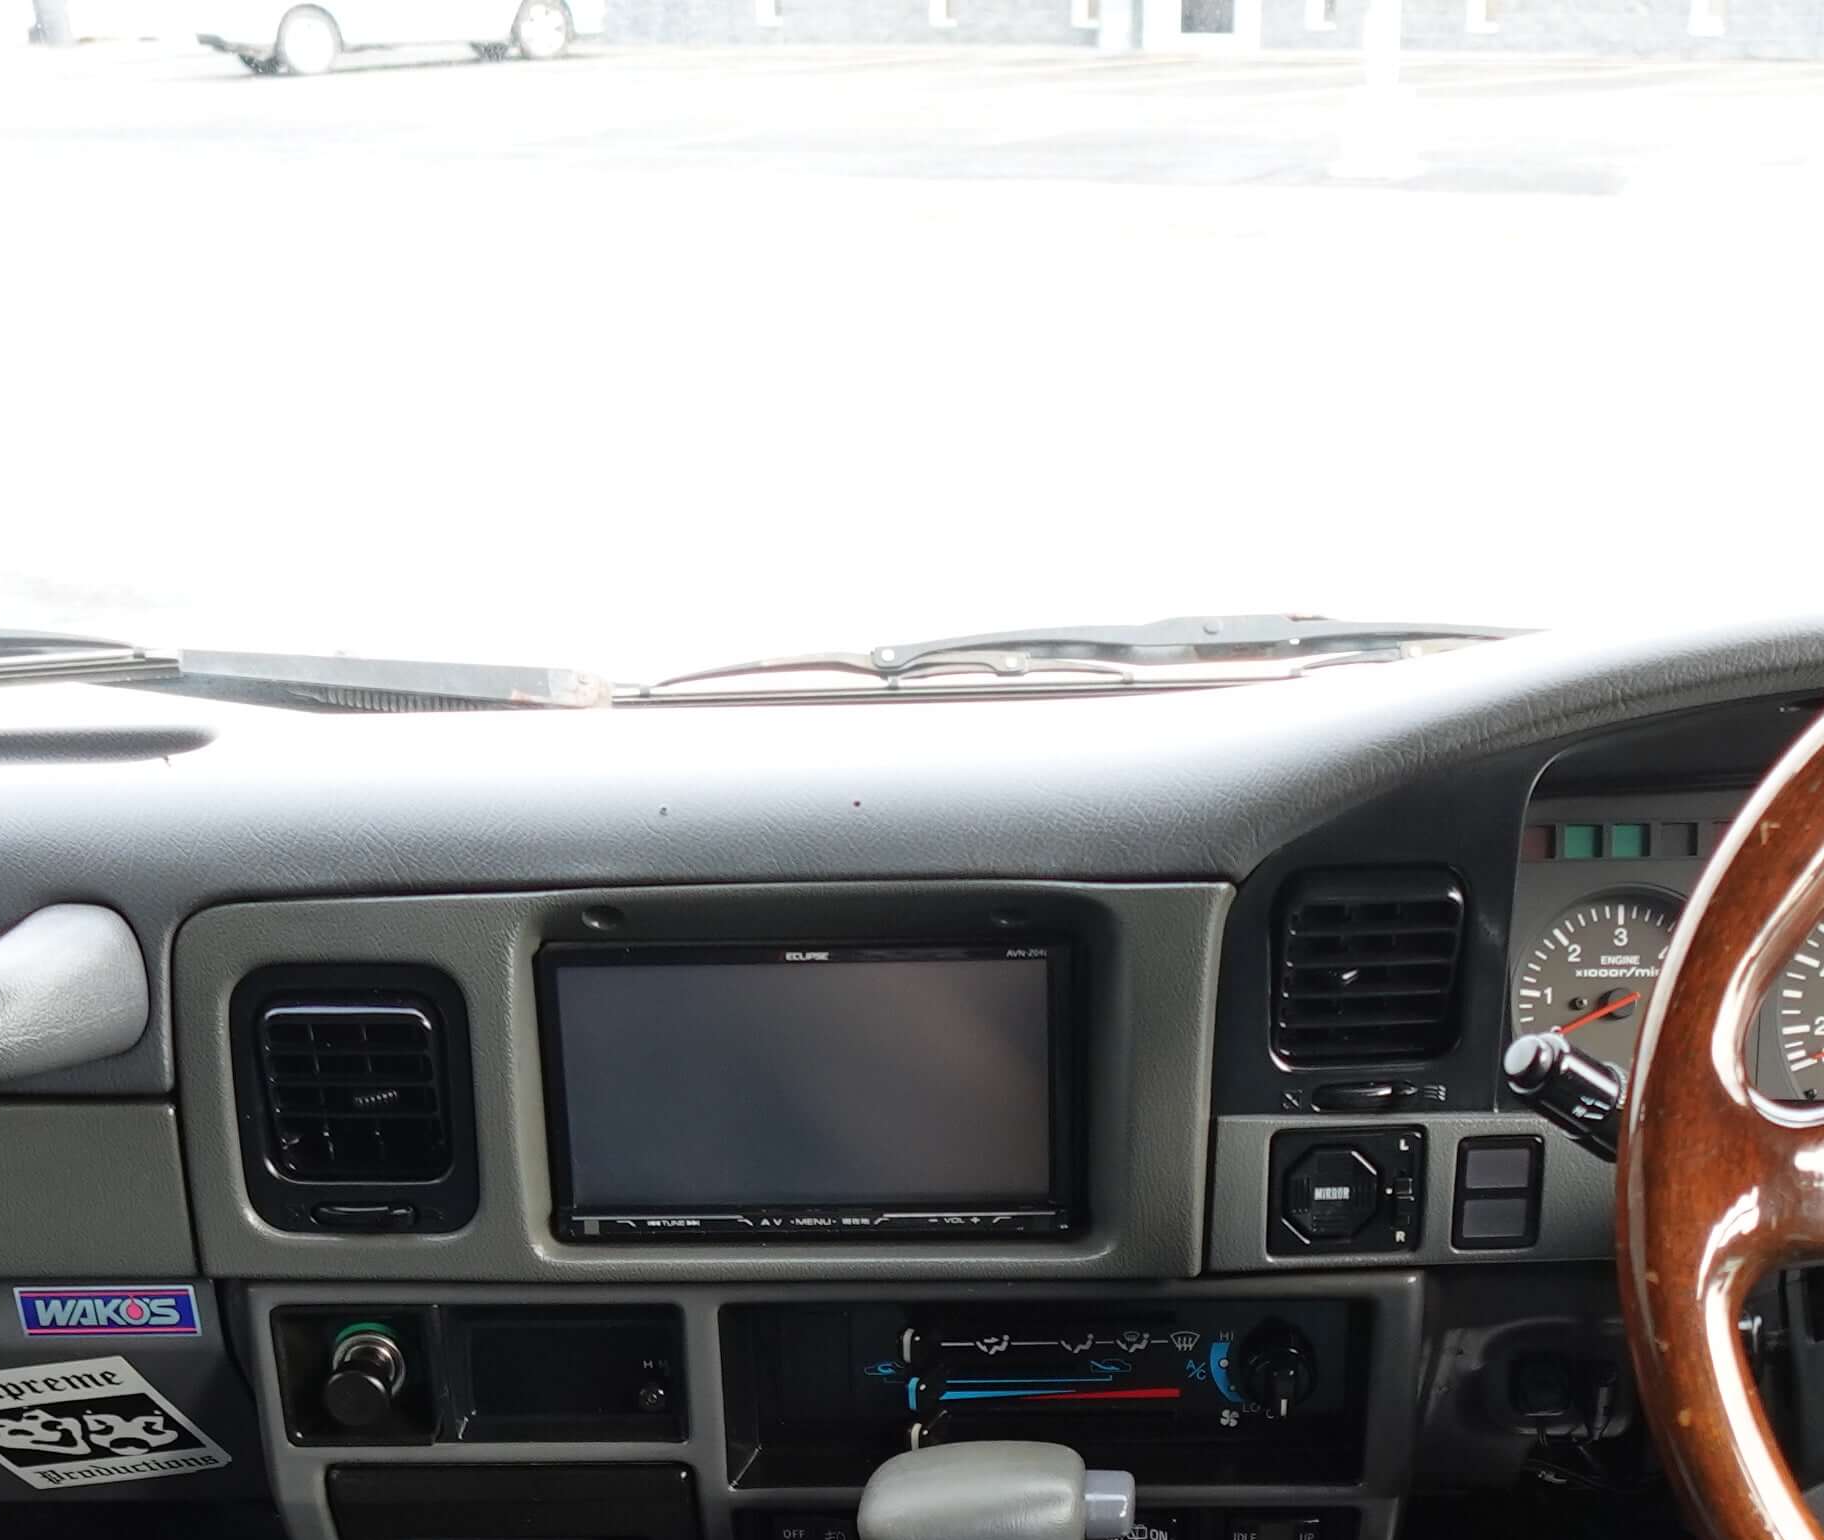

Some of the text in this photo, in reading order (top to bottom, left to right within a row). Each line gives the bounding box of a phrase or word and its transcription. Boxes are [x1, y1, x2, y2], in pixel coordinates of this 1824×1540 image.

[1613, 928, 1629, 946] 3
[1568, 944, 1582, 962] 2
[1600, 955, 1641, 965] ENGINE
[1543, 987, 1553, 1005] 1
[1399, 1138, 1409, 1151] L
[1313, 1186, 1350, 1201] MIRROR
[795, 1217, 832, 1226] MENU
[943, 1216, 965, 1225] VOL
[1395, 1230, 1406, 1243] R
[1185, 1359, 1207, 1382] A/C
[35, 1453, 222, 1485] Productions
[783, 1528, 807, 1540] OFF
